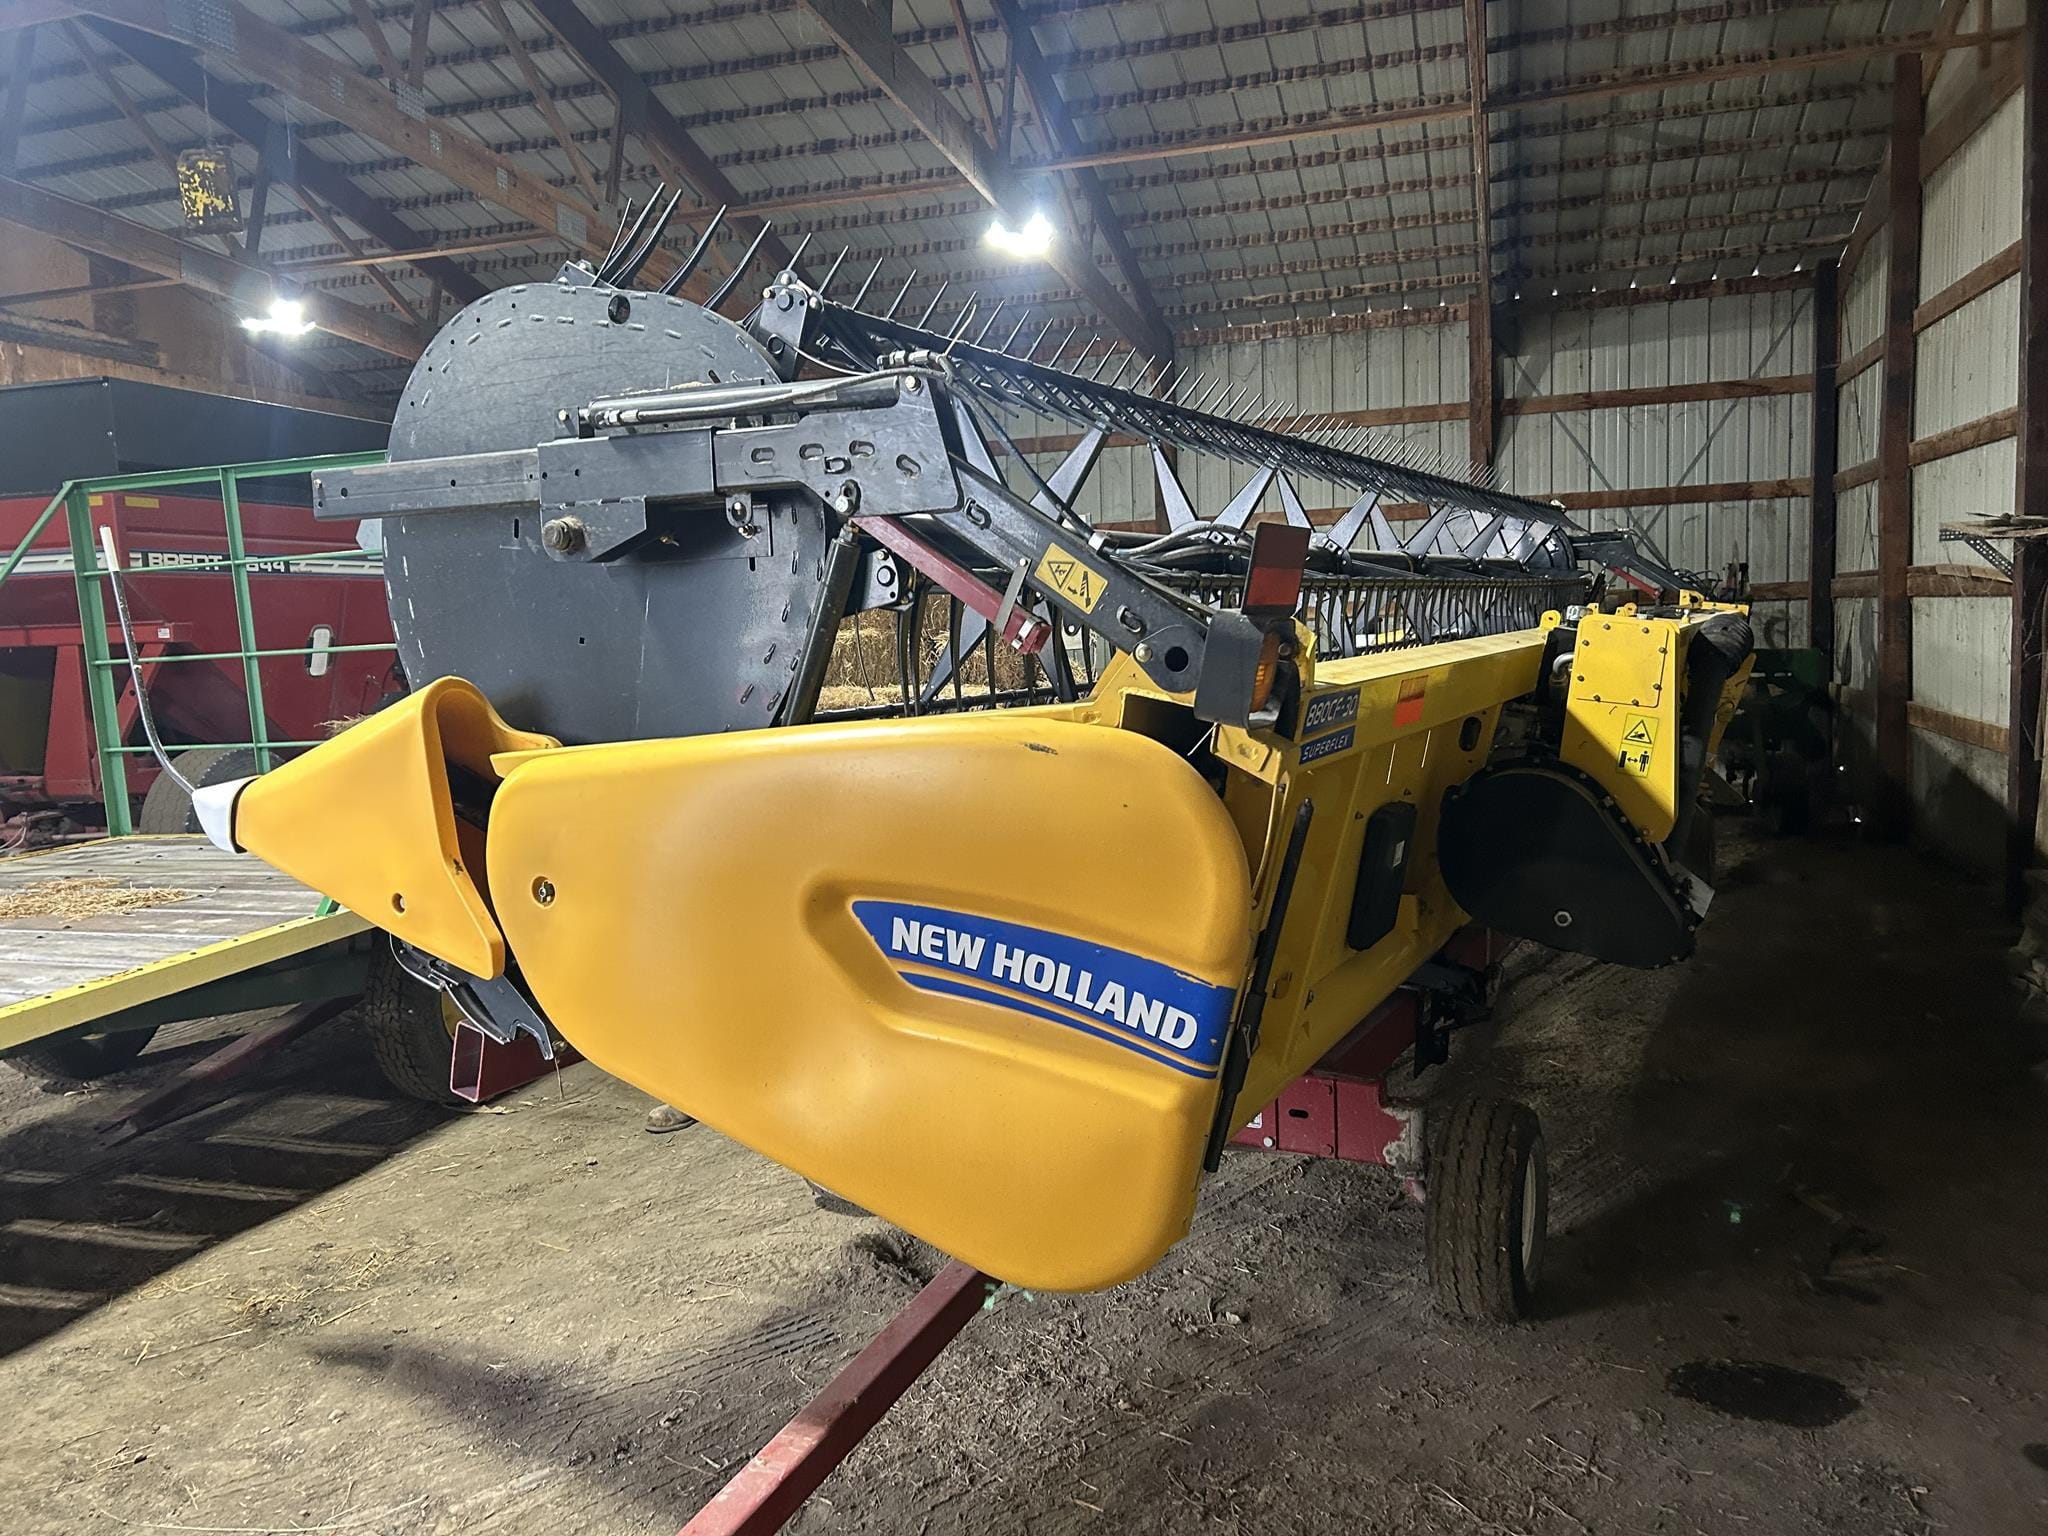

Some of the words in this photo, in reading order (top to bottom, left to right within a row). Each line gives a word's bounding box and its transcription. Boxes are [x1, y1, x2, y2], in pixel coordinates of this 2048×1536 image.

[148, 552, 222, 571] BRENT
[1306, 694, 1359, 727] 880CF-30
[1302, 735, 1350, 761] SUPERFLEX
[891, 917, 985, 971] NEW
[991, 942, 1198, 1050] HOLLAND
